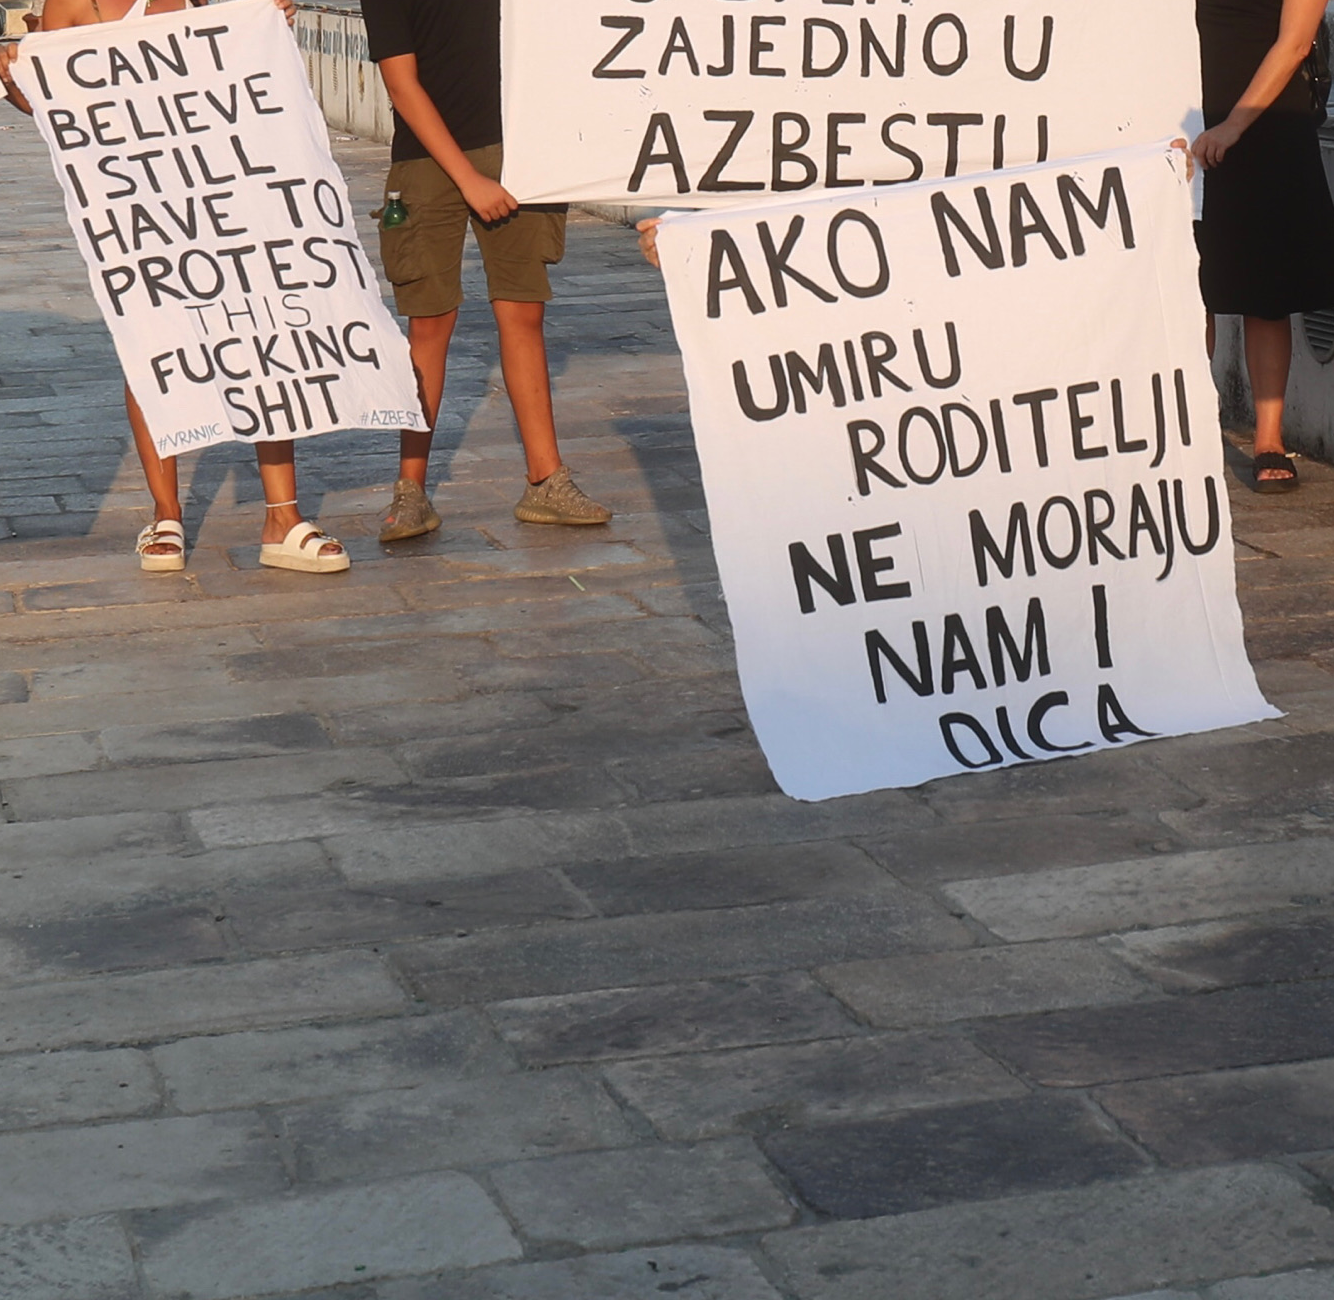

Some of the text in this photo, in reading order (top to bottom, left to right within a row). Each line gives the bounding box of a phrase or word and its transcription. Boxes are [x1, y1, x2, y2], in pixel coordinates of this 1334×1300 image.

[31, 26, 228, 99] I CAN'T
[593, 15, 1053, 81] ZAJEDNO U
[48, 73, 283, 150] BELIEVE
[66, 136, 276, 207] I STILL
[628, 111, 1049, 192] AZBESTU
[83, 179, 343, 261] HAVE TO
[705, 166, 1135, 318] AKO NAM
[102, 238, 367, 315] PROTEST
[185, 295, 312, 333] THIS
[152, 322, 380, 393] FUCKING
[732, 321, 963, 421] UMIRU
[156, 422, 223, 450] #VRANJIC
[226, 375, 339, 436] SHIT
[360, 409, 421, 427] #AZBEST
[848, 368, 1190, 495] RODITELJI
[789, 476, 1220, 612] NE MORAJU
[865, 585, 1111, 703] NAM I
[938, 684, 1163, 769] DICA
